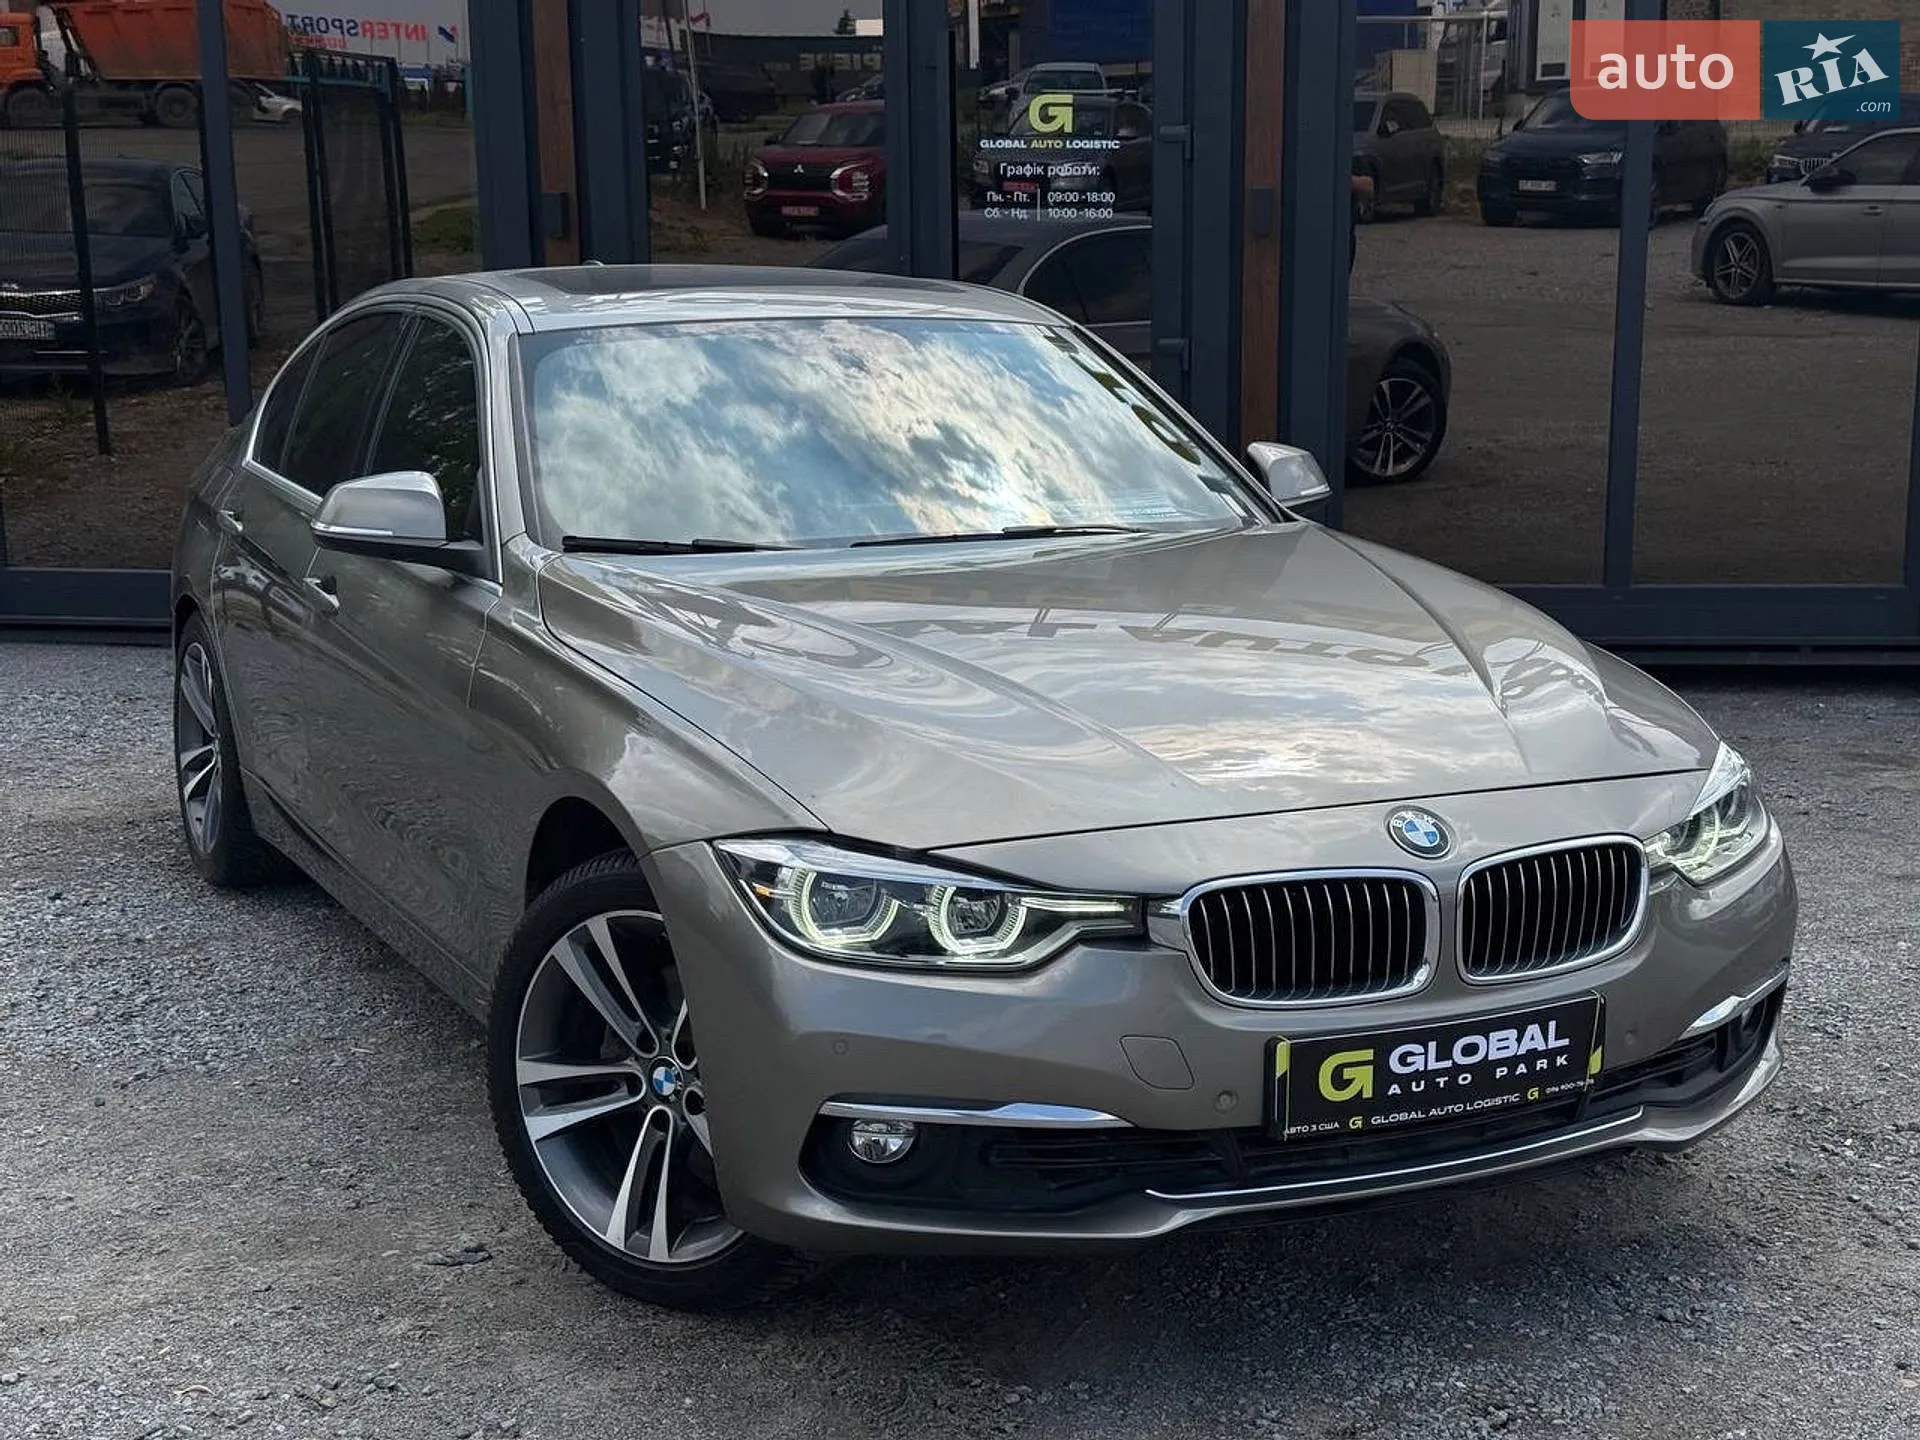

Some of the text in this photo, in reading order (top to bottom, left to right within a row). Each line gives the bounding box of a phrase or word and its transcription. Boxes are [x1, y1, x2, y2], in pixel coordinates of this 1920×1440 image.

[980, 139, 1121, 149] GLOBAL AUTO LOGISTIC
[1000, 162, 1100, 178] Графік роботи:
[1047, 191, 1080, 202] 09:00
[1047, 207, 1077, 219] 10:00
[1388, 1020, 1570, 1074] GLOBAL
[1387, 1054, 1570, 1096] AUTO PARK
[1371, 1092, 1521, 1125] GLOBAL AUTO LOGISTIC
